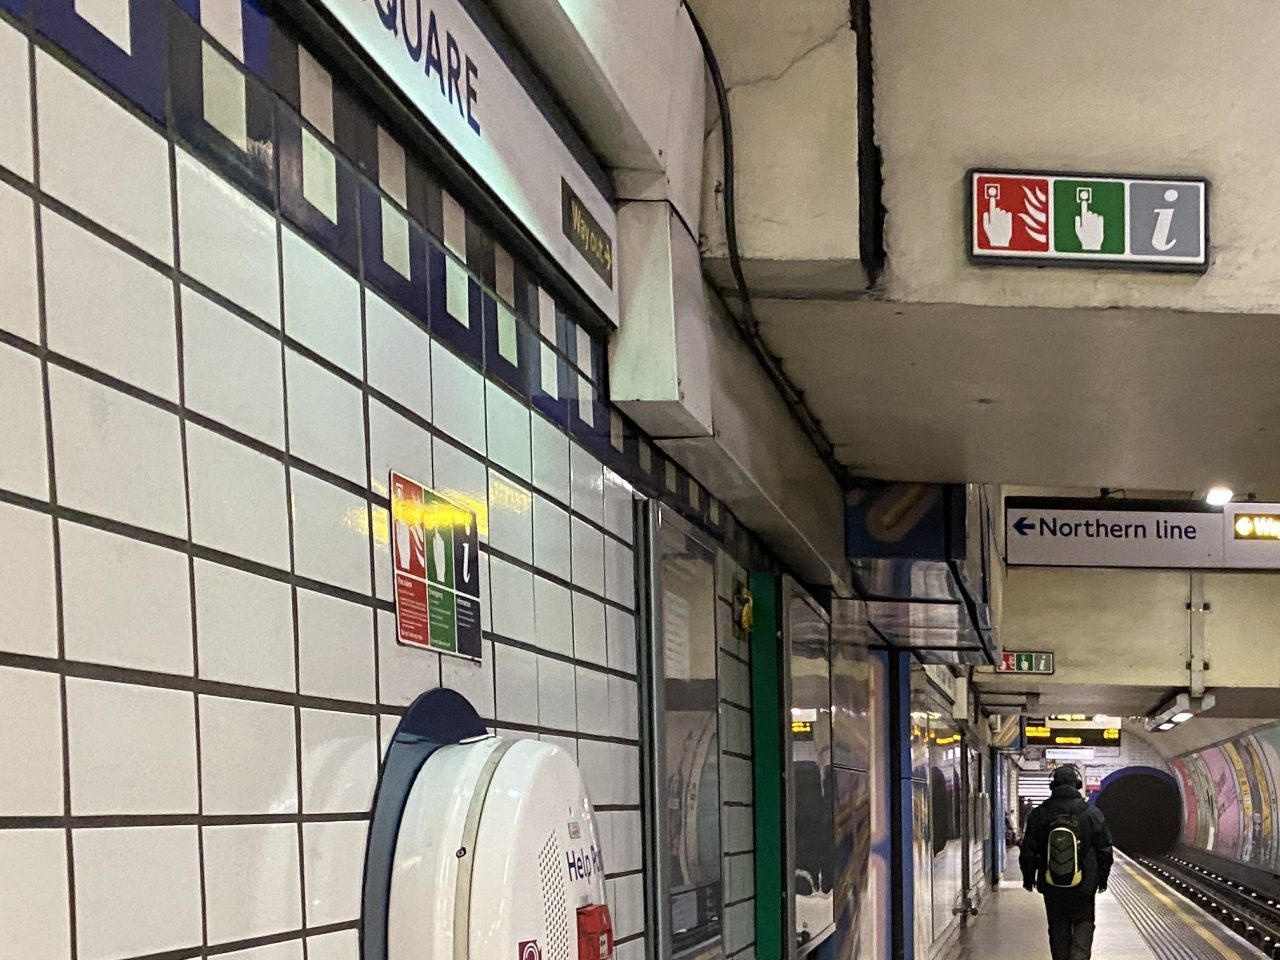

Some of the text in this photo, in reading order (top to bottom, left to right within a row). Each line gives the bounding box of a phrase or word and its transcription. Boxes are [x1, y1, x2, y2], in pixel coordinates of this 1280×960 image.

[571, 200, 590, 251] Way
[1039, 517, 1197, 540] Northern line
[566, 848, 591, 885] Help
